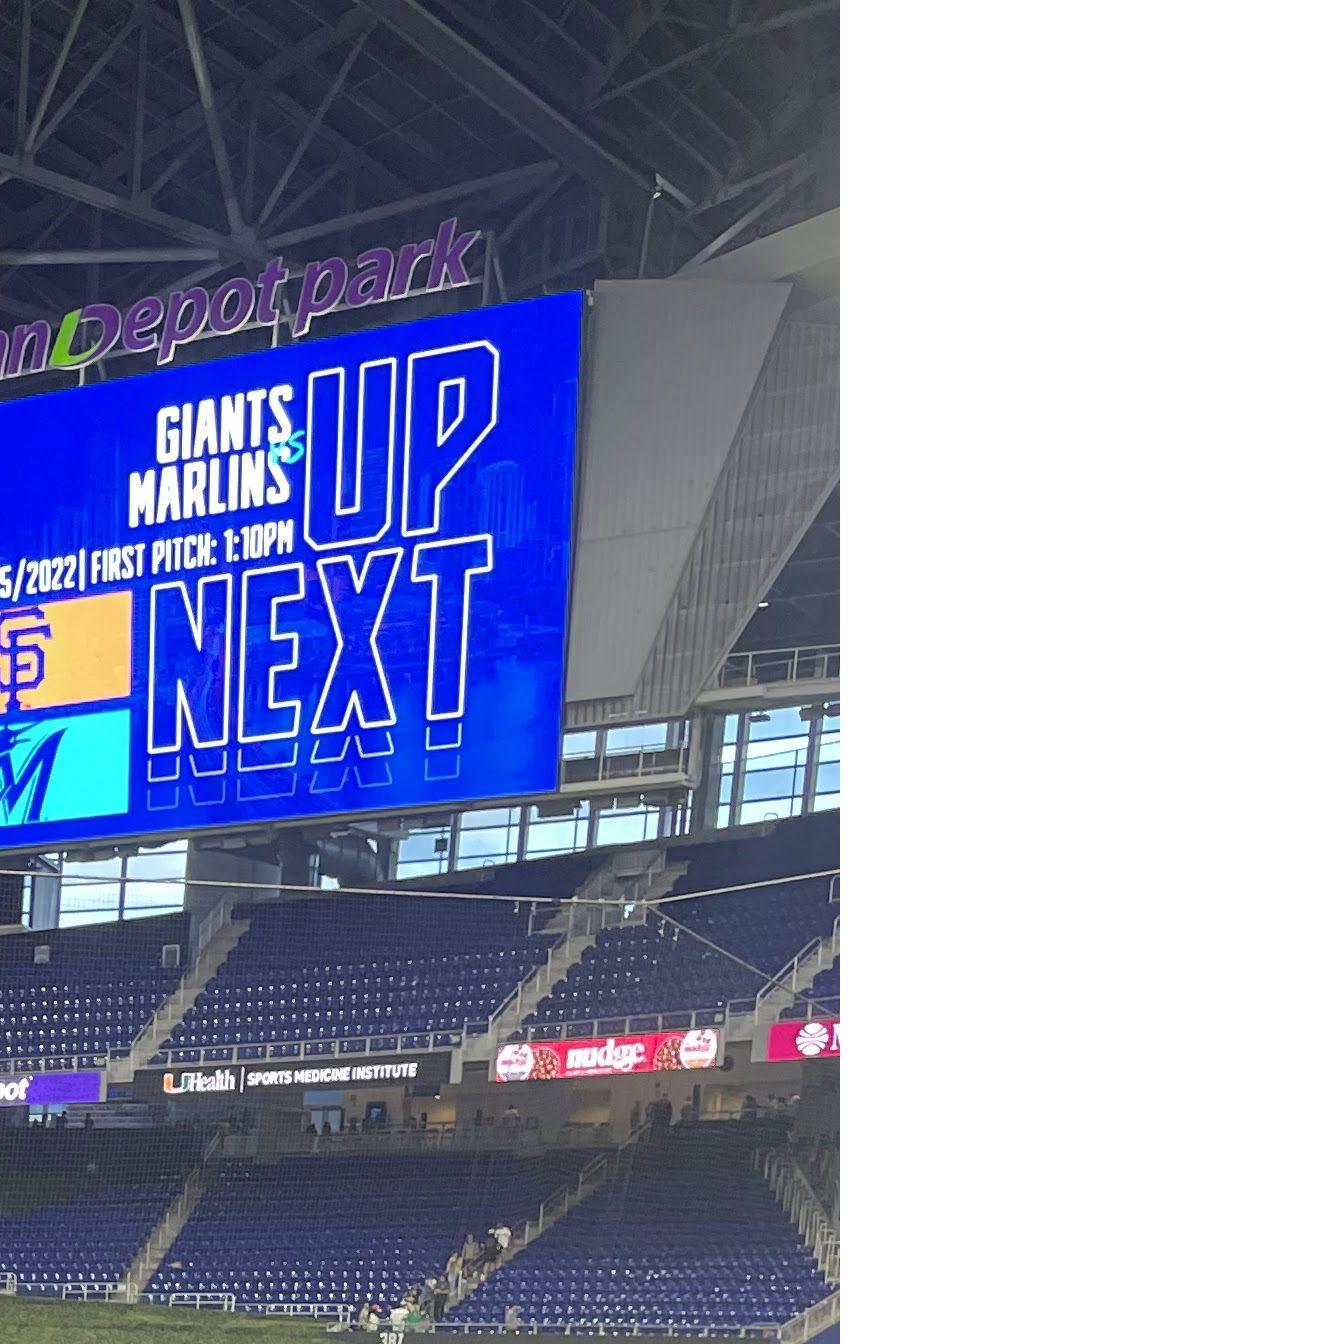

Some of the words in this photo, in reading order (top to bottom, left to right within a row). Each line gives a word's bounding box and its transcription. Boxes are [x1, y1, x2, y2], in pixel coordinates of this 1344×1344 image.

[293, 217, 480, 338] park
[156, 385, 293, 464] GIANTS
[303, 339, 500, 551] UP
[129, 449, 291, 528] MARLINS
[90, 544, 145, 585] FIRST
[151, 532, 218, 573] PITCH:
[224, 519, 294, 562] 1:10PM
[147, 535, 493, 756] NEXT
[247, 1070, 293, 1086] SPORTS
[294, 1065, 350, 1084] MEDICINE
[352, 1062, 419, 1081] INSTITUTE
[565, 1037, 646, 1073] nudge
